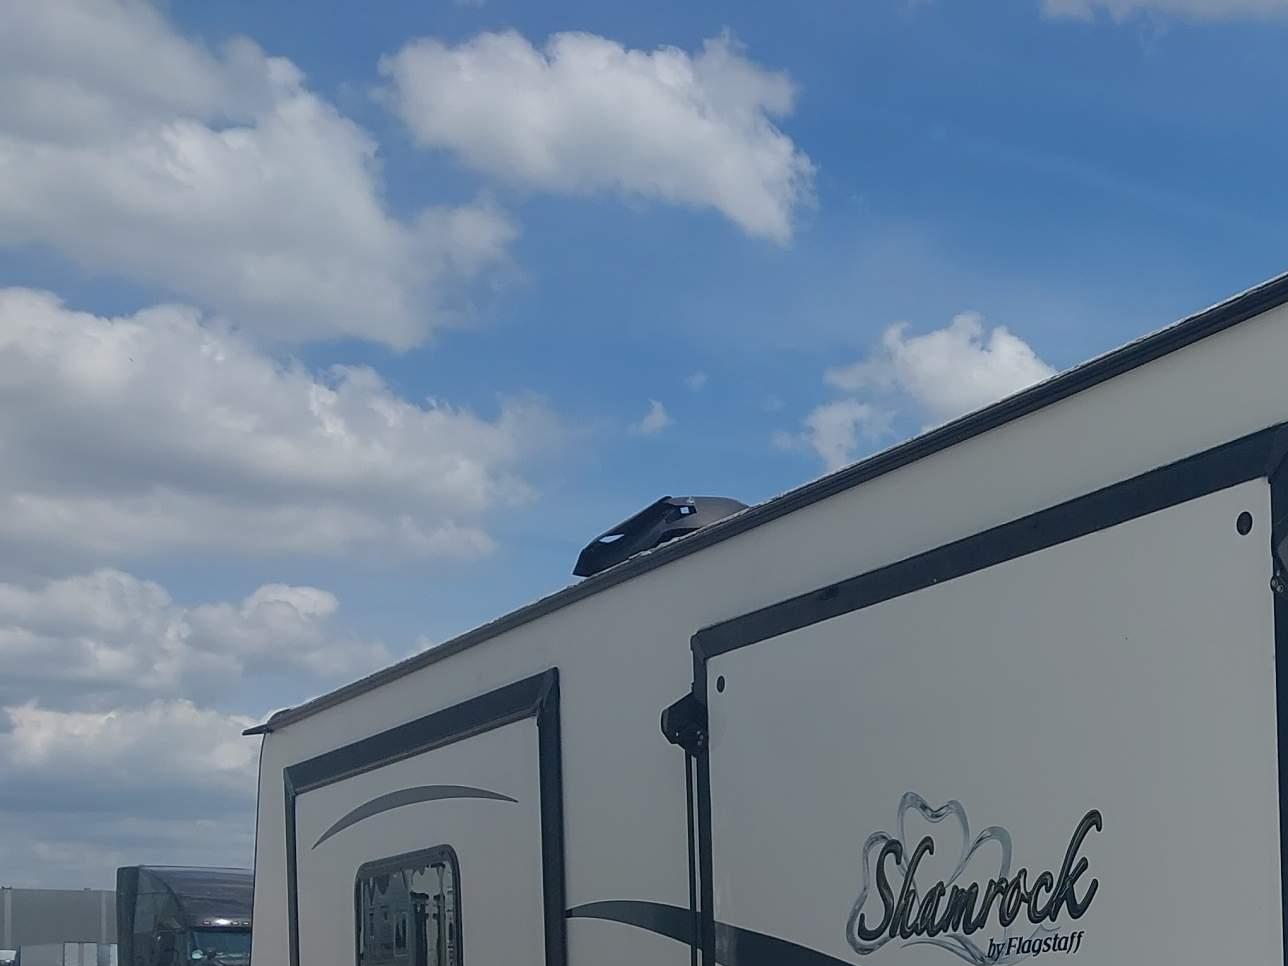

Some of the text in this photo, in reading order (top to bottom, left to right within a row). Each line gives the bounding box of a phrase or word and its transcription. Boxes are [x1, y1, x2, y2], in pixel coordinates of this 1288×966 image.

[857, 808, 1103, 942] Shamrock
[987, 930, 1086, 959] by Flagstaff
